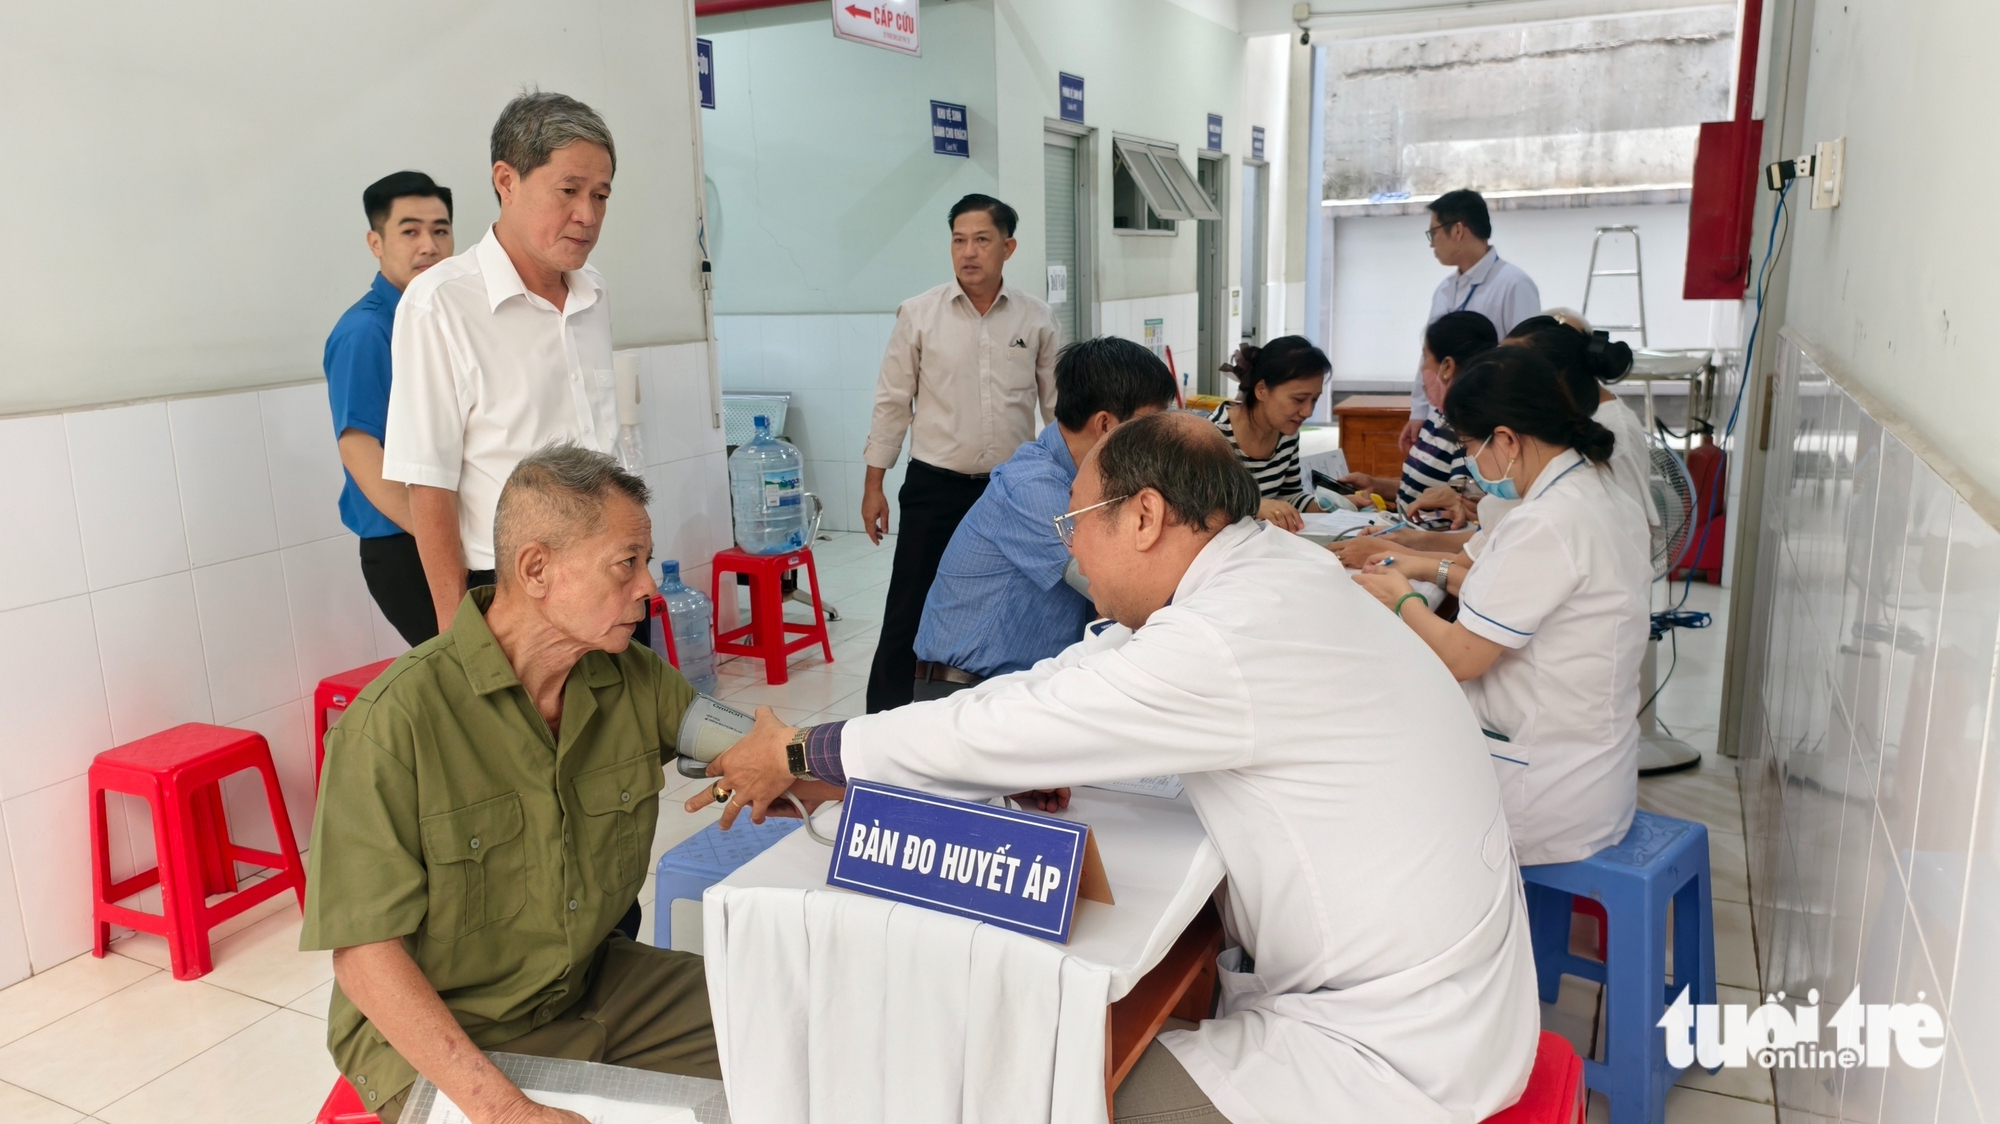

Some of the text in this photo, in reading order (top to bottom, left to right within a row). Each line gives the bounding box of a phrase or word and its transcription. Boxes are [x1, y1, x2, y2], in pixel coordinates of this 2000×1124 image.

[873, 3, 914, 35] CẤP CỨU
[848, 819, 1061, 904] BÀN ĐO HUYẾT ÁP
